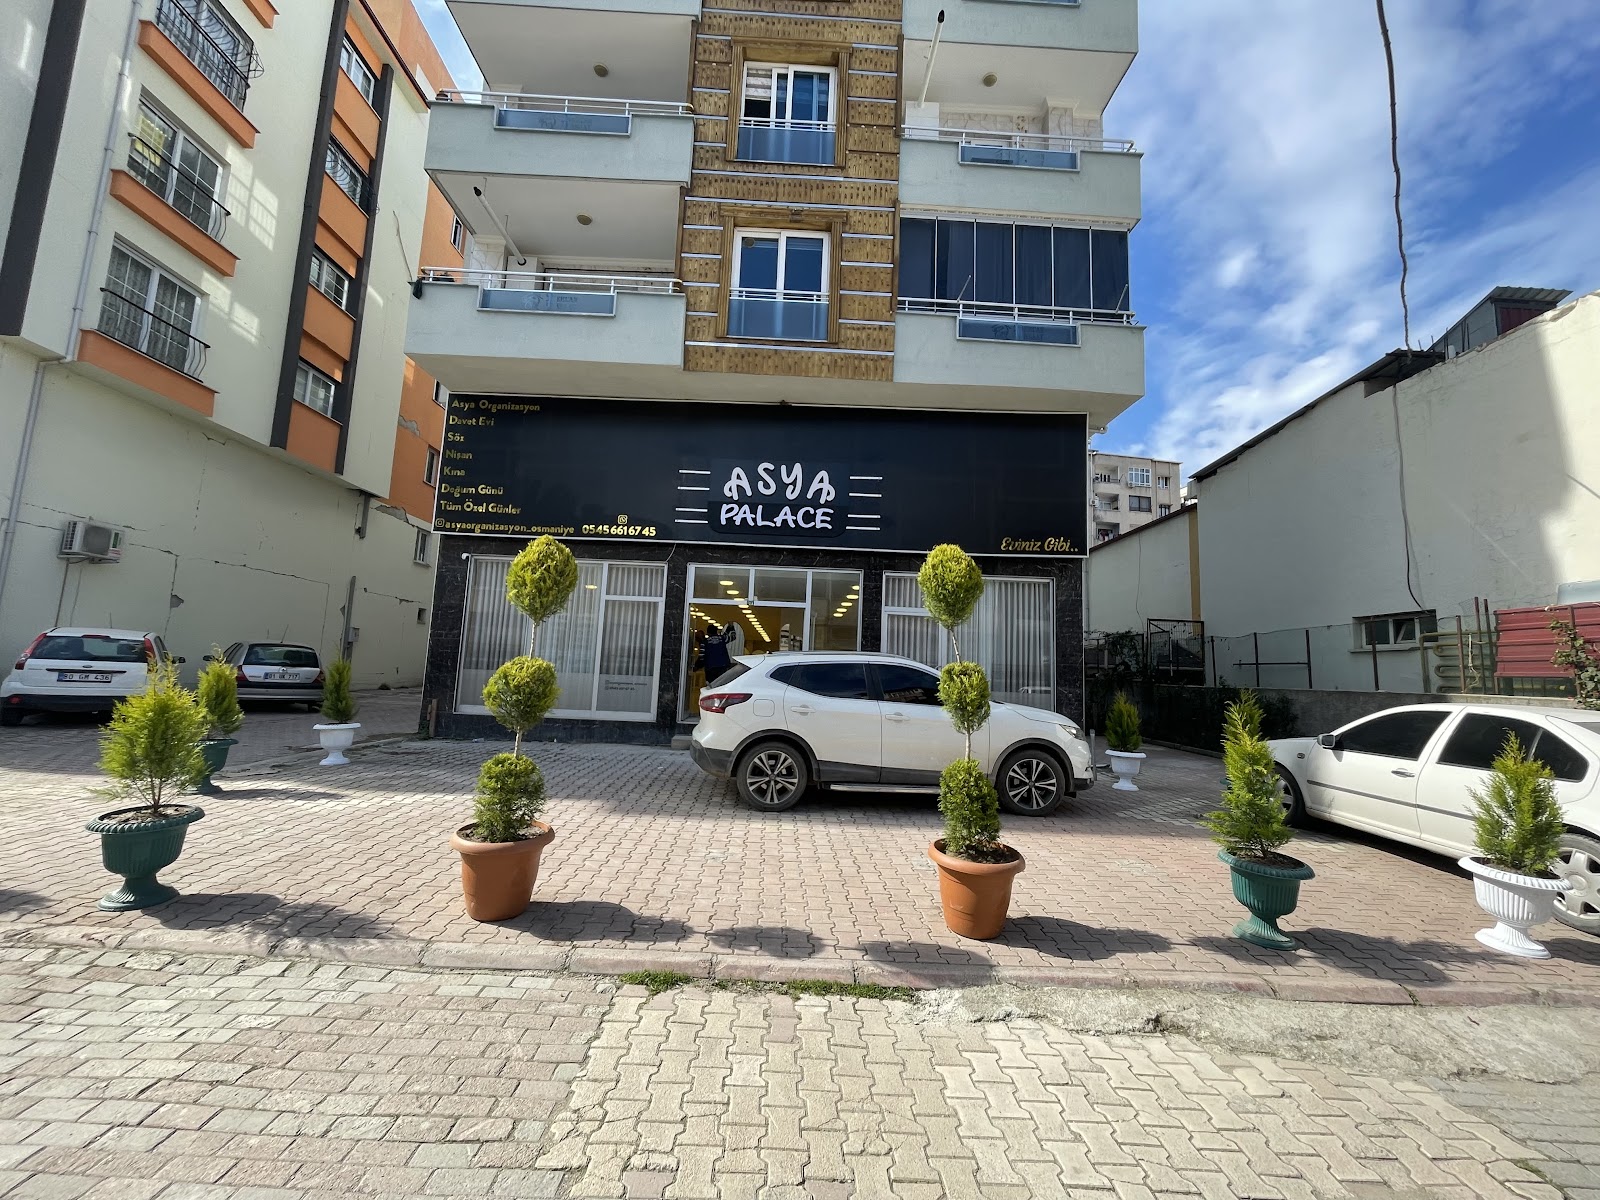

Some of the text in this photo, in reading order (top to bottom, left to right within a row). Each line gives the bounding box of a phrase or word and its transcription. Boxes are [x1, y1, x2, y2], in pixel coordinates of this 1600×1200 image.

[451, 399, 540, 414] Asya Organizasyon
[449, 415, 495, 426] Davet Evi
[447, 431, 465, 442] Söz
[445, 449, 473, 460] Nişan
[443, 466, 466, 476] Kına
[441, 483, 504, 498] Doğum Günü
[723, 462, 836, 504] ASYA
[440, 498, 521, 515] Tüm Özel Günler
[720, 503, 835, 530] PALACE
[582, 524, 657, 537] 05456616745
[1000, 537, 1042, 552] Eviniz
